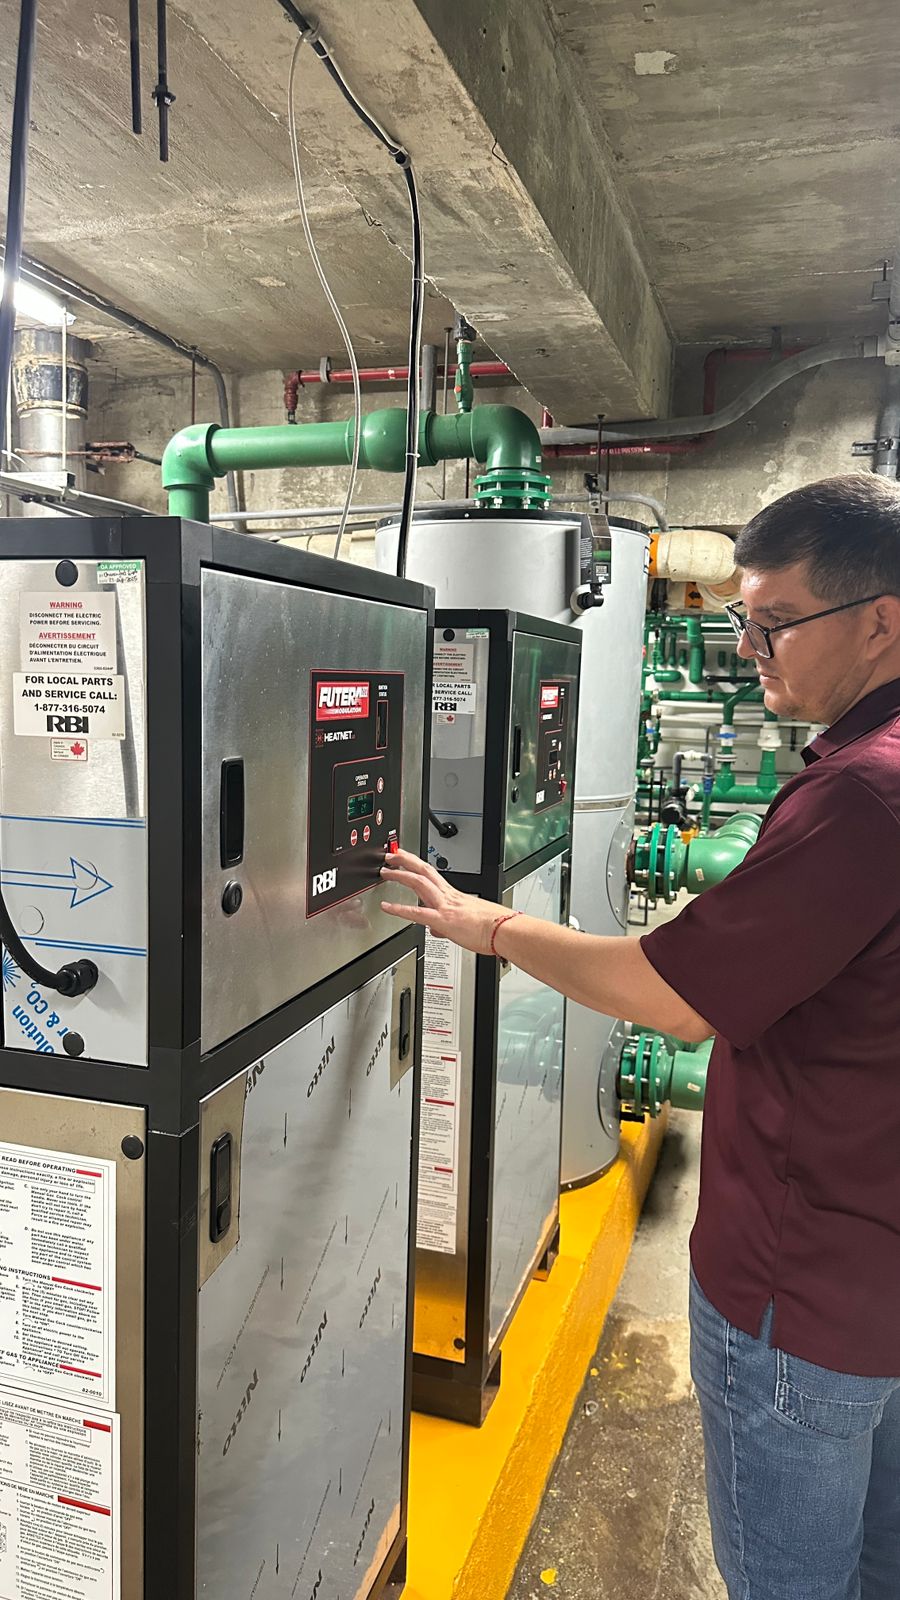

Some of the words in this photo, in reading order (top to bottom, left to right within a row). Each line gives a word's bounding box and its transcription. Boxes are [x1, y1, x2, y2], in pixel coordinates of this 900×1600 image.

[25, 676, 45, 684] FOR
[47, 677, 79, 685] LOCAL
[82, 677, 113, 686] PARTS
[22, 690, 42, 698] AND
[45, 690, 86, 698] SERVICE
[89, 692, 117, 700] CALL:
[319, 687, 362, 707] FUTERA
[34, 704, 105, 713] 1-877-316-5074
[435, 702, 457, 711] RBI
[47, 715, 89, 733] RBI
[324, 731, 352, 742] HEATNET
[312, 868, 337, 897] RBI
[366, 1023, 389, 1077] Nitto
[307, 1035, 336, 1098] Nitto
[10, 1166, 35, 1175] instructions
[18, 1159, 40, 1167] BEFORE
[43, 1163, 76, 1173] OPERATING
[9, 1267, 50, 1280] INSTRUCTIONS
[359, 1267, 381, 1328] Nitto
[301, 1311, 328, 1383] Nitto
[28, 1356, 59, 1368] APPLIANCE
[37, 1409, 54, 1417] METTRE
[62, 1416, 81, 1424] MARCHE
[223, 1369, 259, 1457] Nitto
[36, 1490, 54, 1499] MARCHE
[354, 1498, 375, 1567] Nitto
